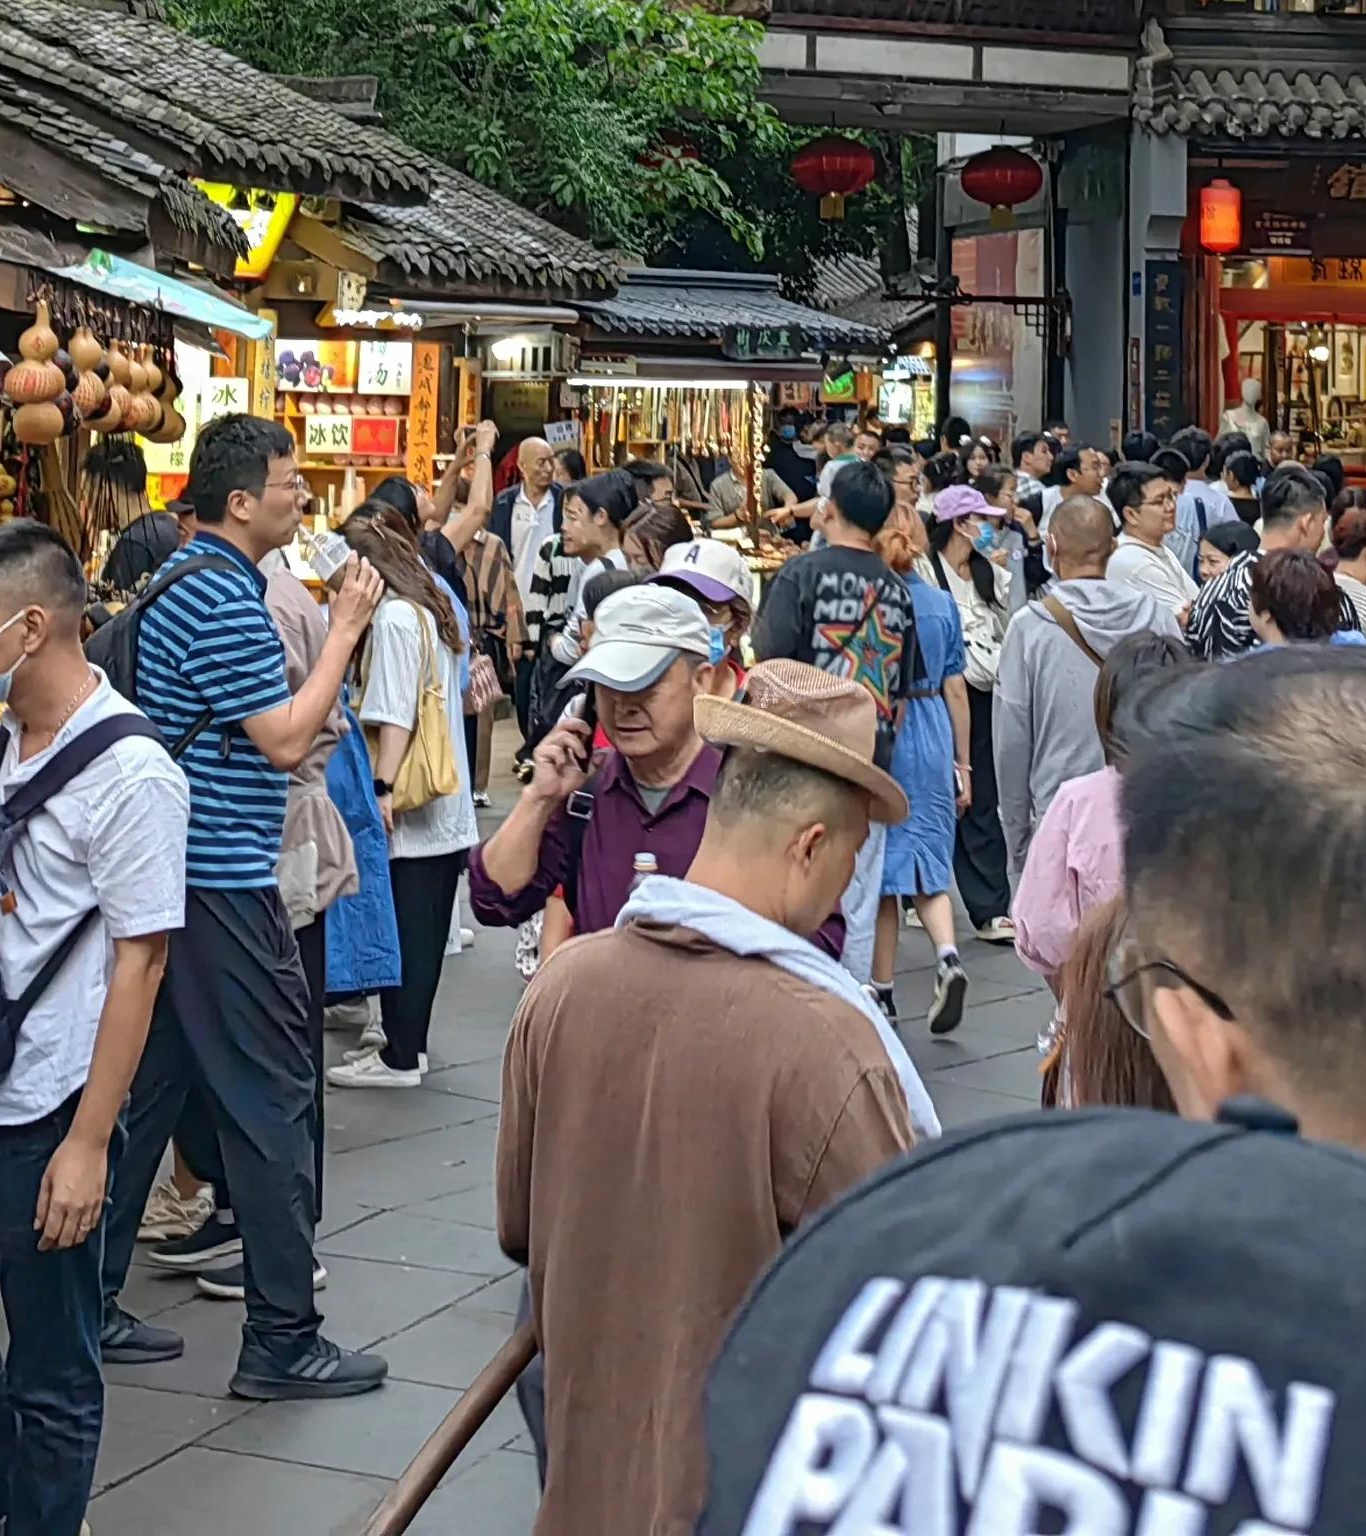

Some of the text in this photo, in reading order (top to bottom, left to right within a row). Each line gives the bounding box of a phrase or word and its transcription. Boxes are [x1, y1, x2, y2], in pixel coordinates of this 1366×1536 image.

[308, 423, 349, 447] 冰饮
[683, 544, 701, 565] A
[807, 1275, 1337, 1531] LINKIN
[740, 1389, 1313, 1536] PAR
